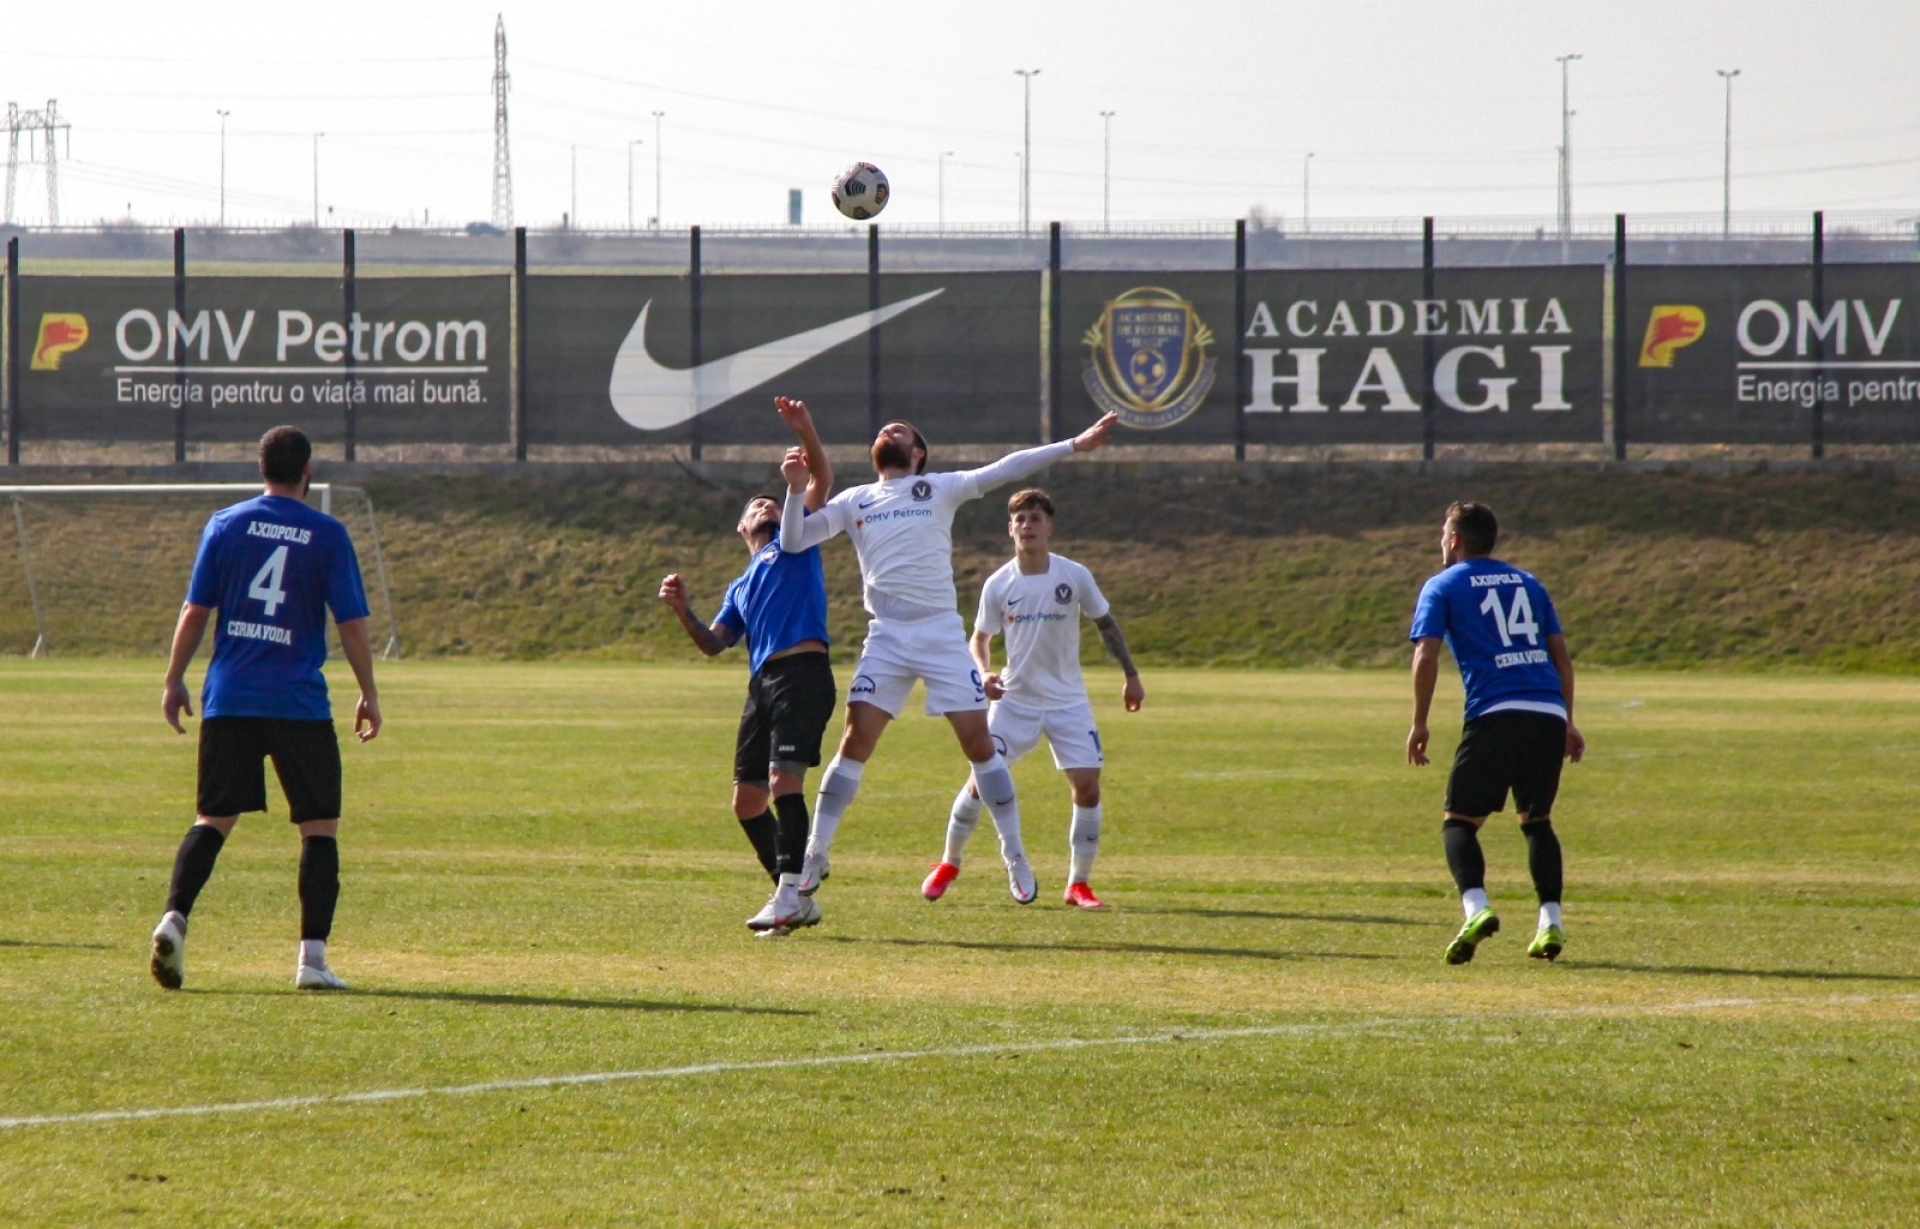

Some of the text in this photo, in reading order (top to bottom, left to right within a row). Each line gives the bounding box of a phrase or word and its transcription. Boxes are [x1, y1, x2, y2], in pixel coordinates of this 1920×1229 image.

[115, 308, 487, 362] OMV Petrom
[1245, 297, 1573, 337] ACADEMIA
[1736, 299, 1902, 357] OMV
[117, 377, 203, 409] Energia
[211, 380, 283, 409] pentru
[290, 385, 304, 404] o
[374, 379, 415, 404] mai
[423, 379, 488, 404] bună.
[1242, 345, 1573, 413] HAGI
[1738, 375, 1839, 408] Energia
[247, 521, 311, 544] AXIOPOLIS
[864, 509, 932, 524] OMV Petrom
[248, 545, 288, 616] 4
[1479, 586, 1539, 648] 14
[970, 669, 984, 694] 9
